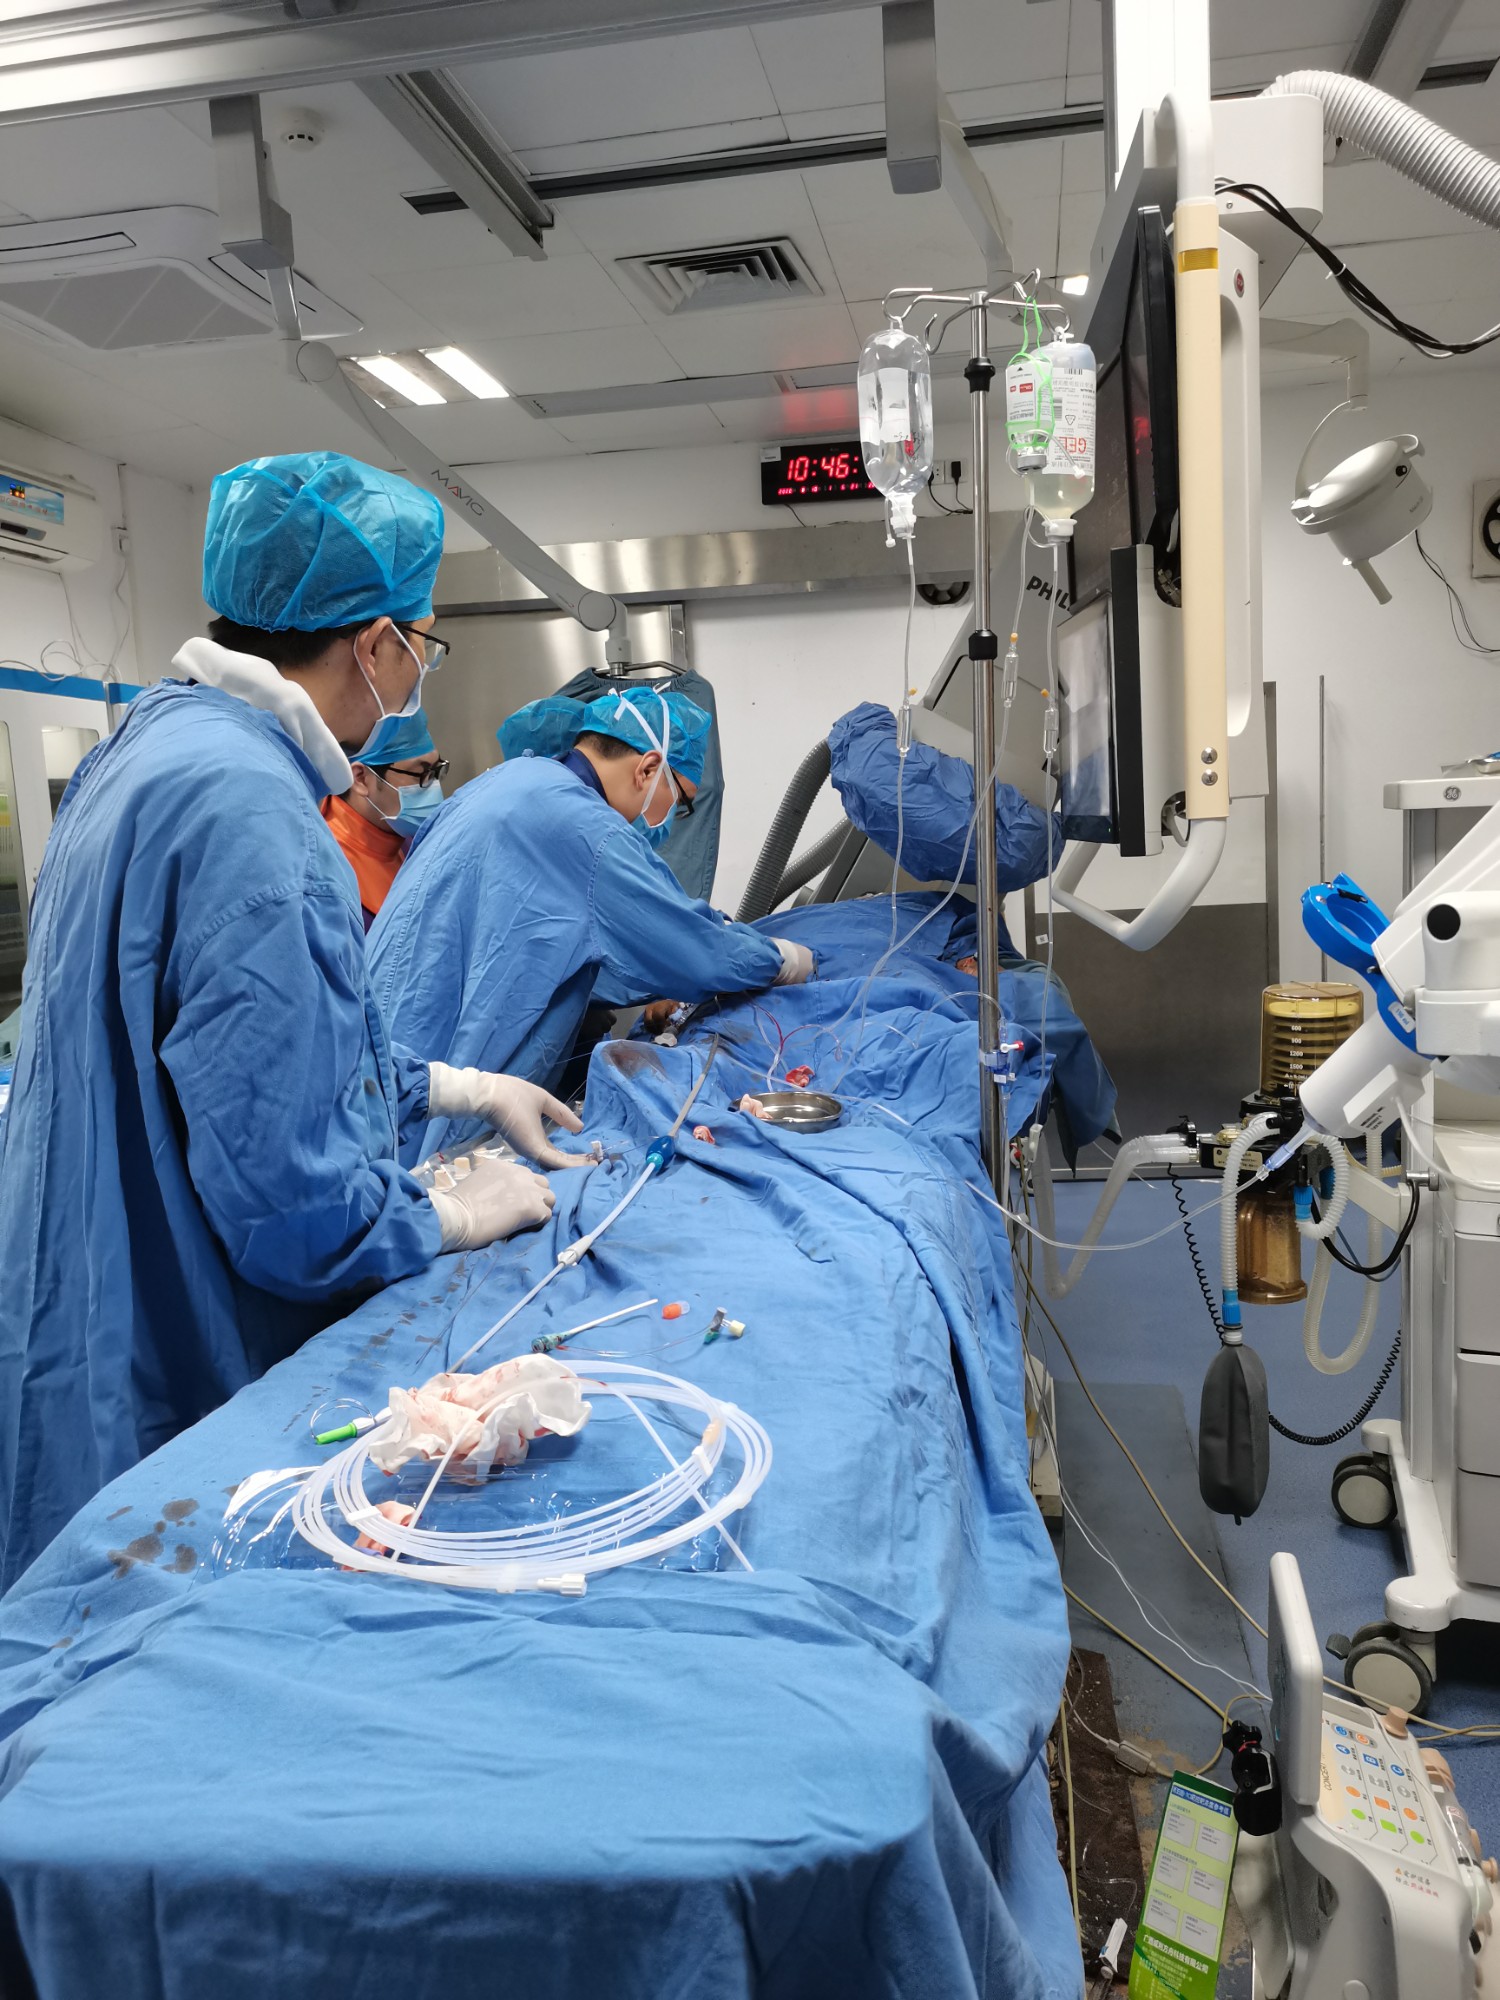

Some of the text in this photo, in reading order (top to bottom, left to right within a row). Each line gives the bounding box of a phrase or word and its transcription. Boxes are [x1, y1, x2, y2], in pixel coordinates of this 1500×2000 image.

[1059, 436, 1087, 454] GEL
[431, 469, 485, 517] MAVIC
[1026, 575, 1070, 612] PHIL
